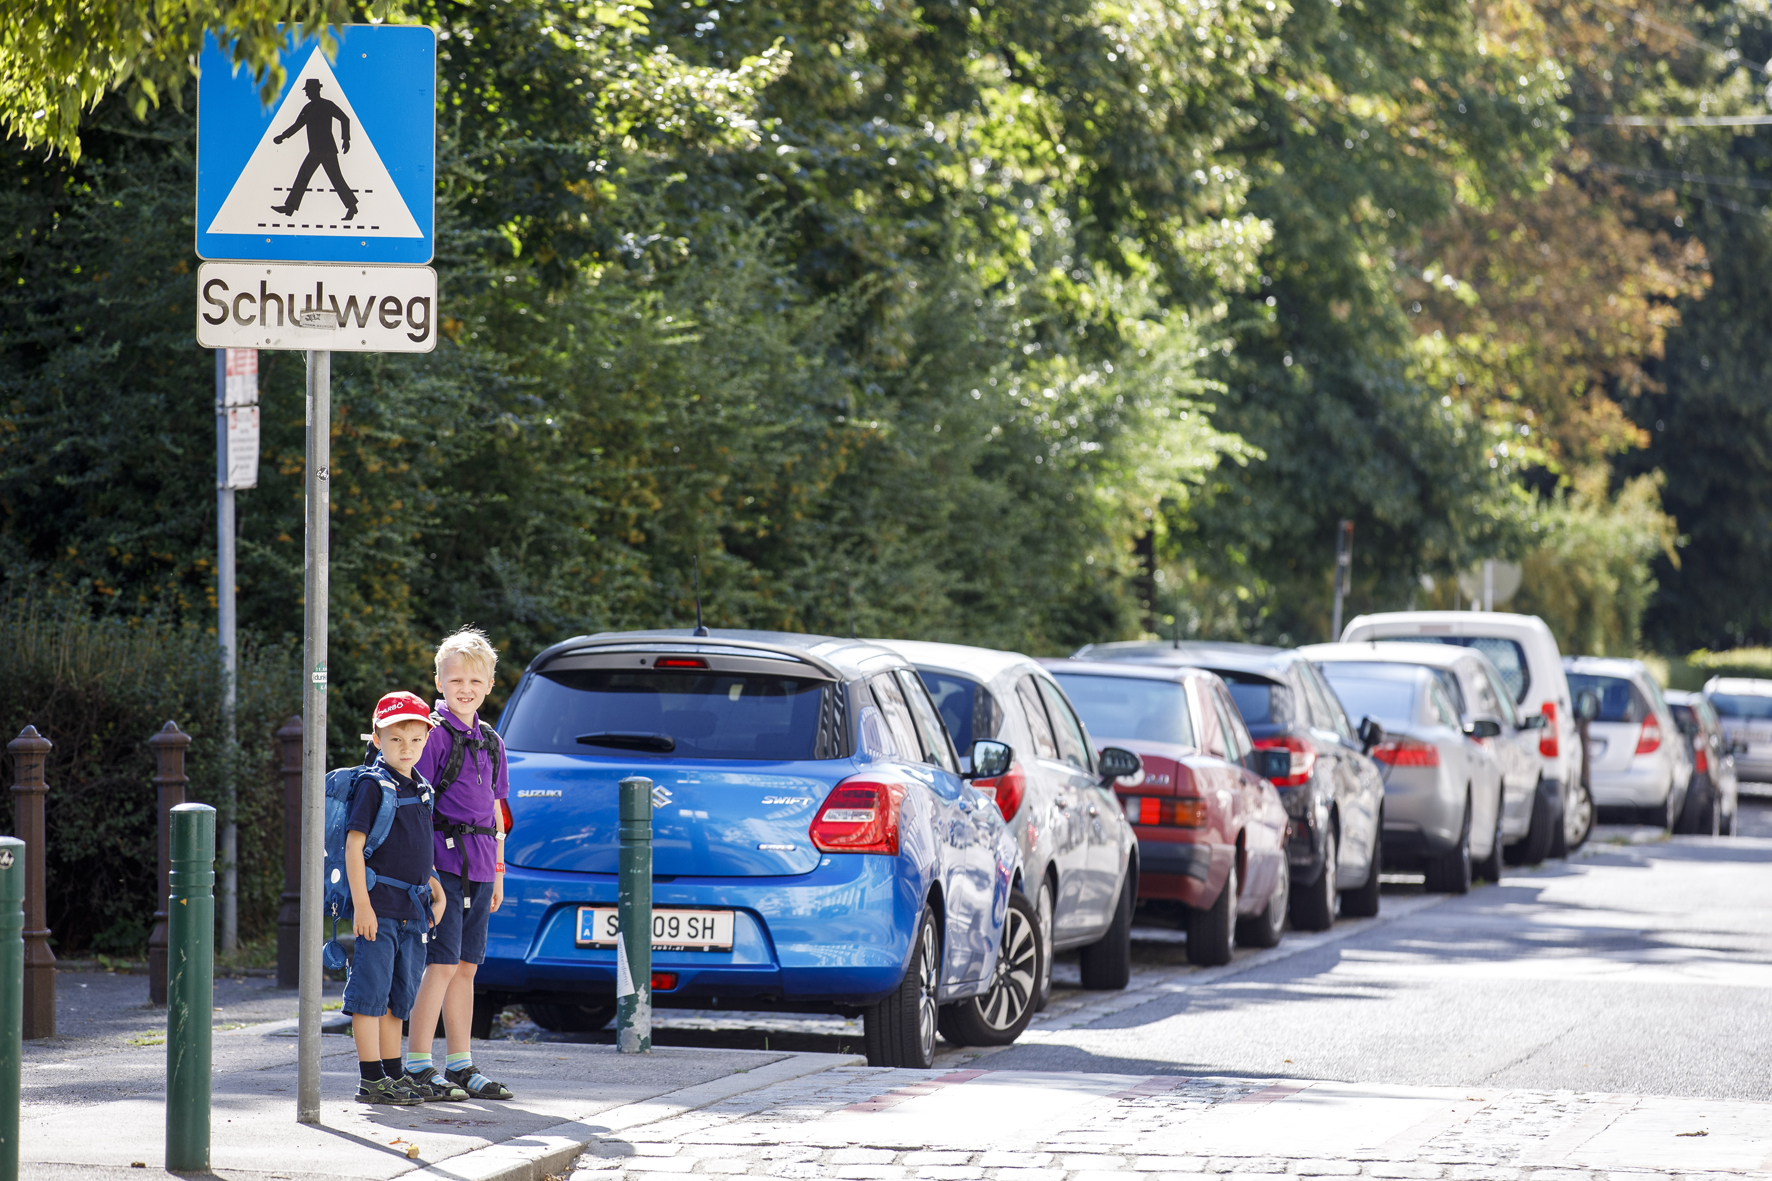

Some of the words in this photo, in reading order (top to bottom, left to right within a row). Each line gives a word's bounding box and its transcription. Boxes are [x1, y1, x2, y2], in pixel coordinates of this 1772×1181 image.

[202, 278, 430, 343] Schulweg
[517, 789, 563, 798] SUZUKI
[761, 795, 813, 806] SWIFT
[583, 928, 591, 937] A
[653, 916, 680, 938] 09
[687, 917, 714, 940] SH
